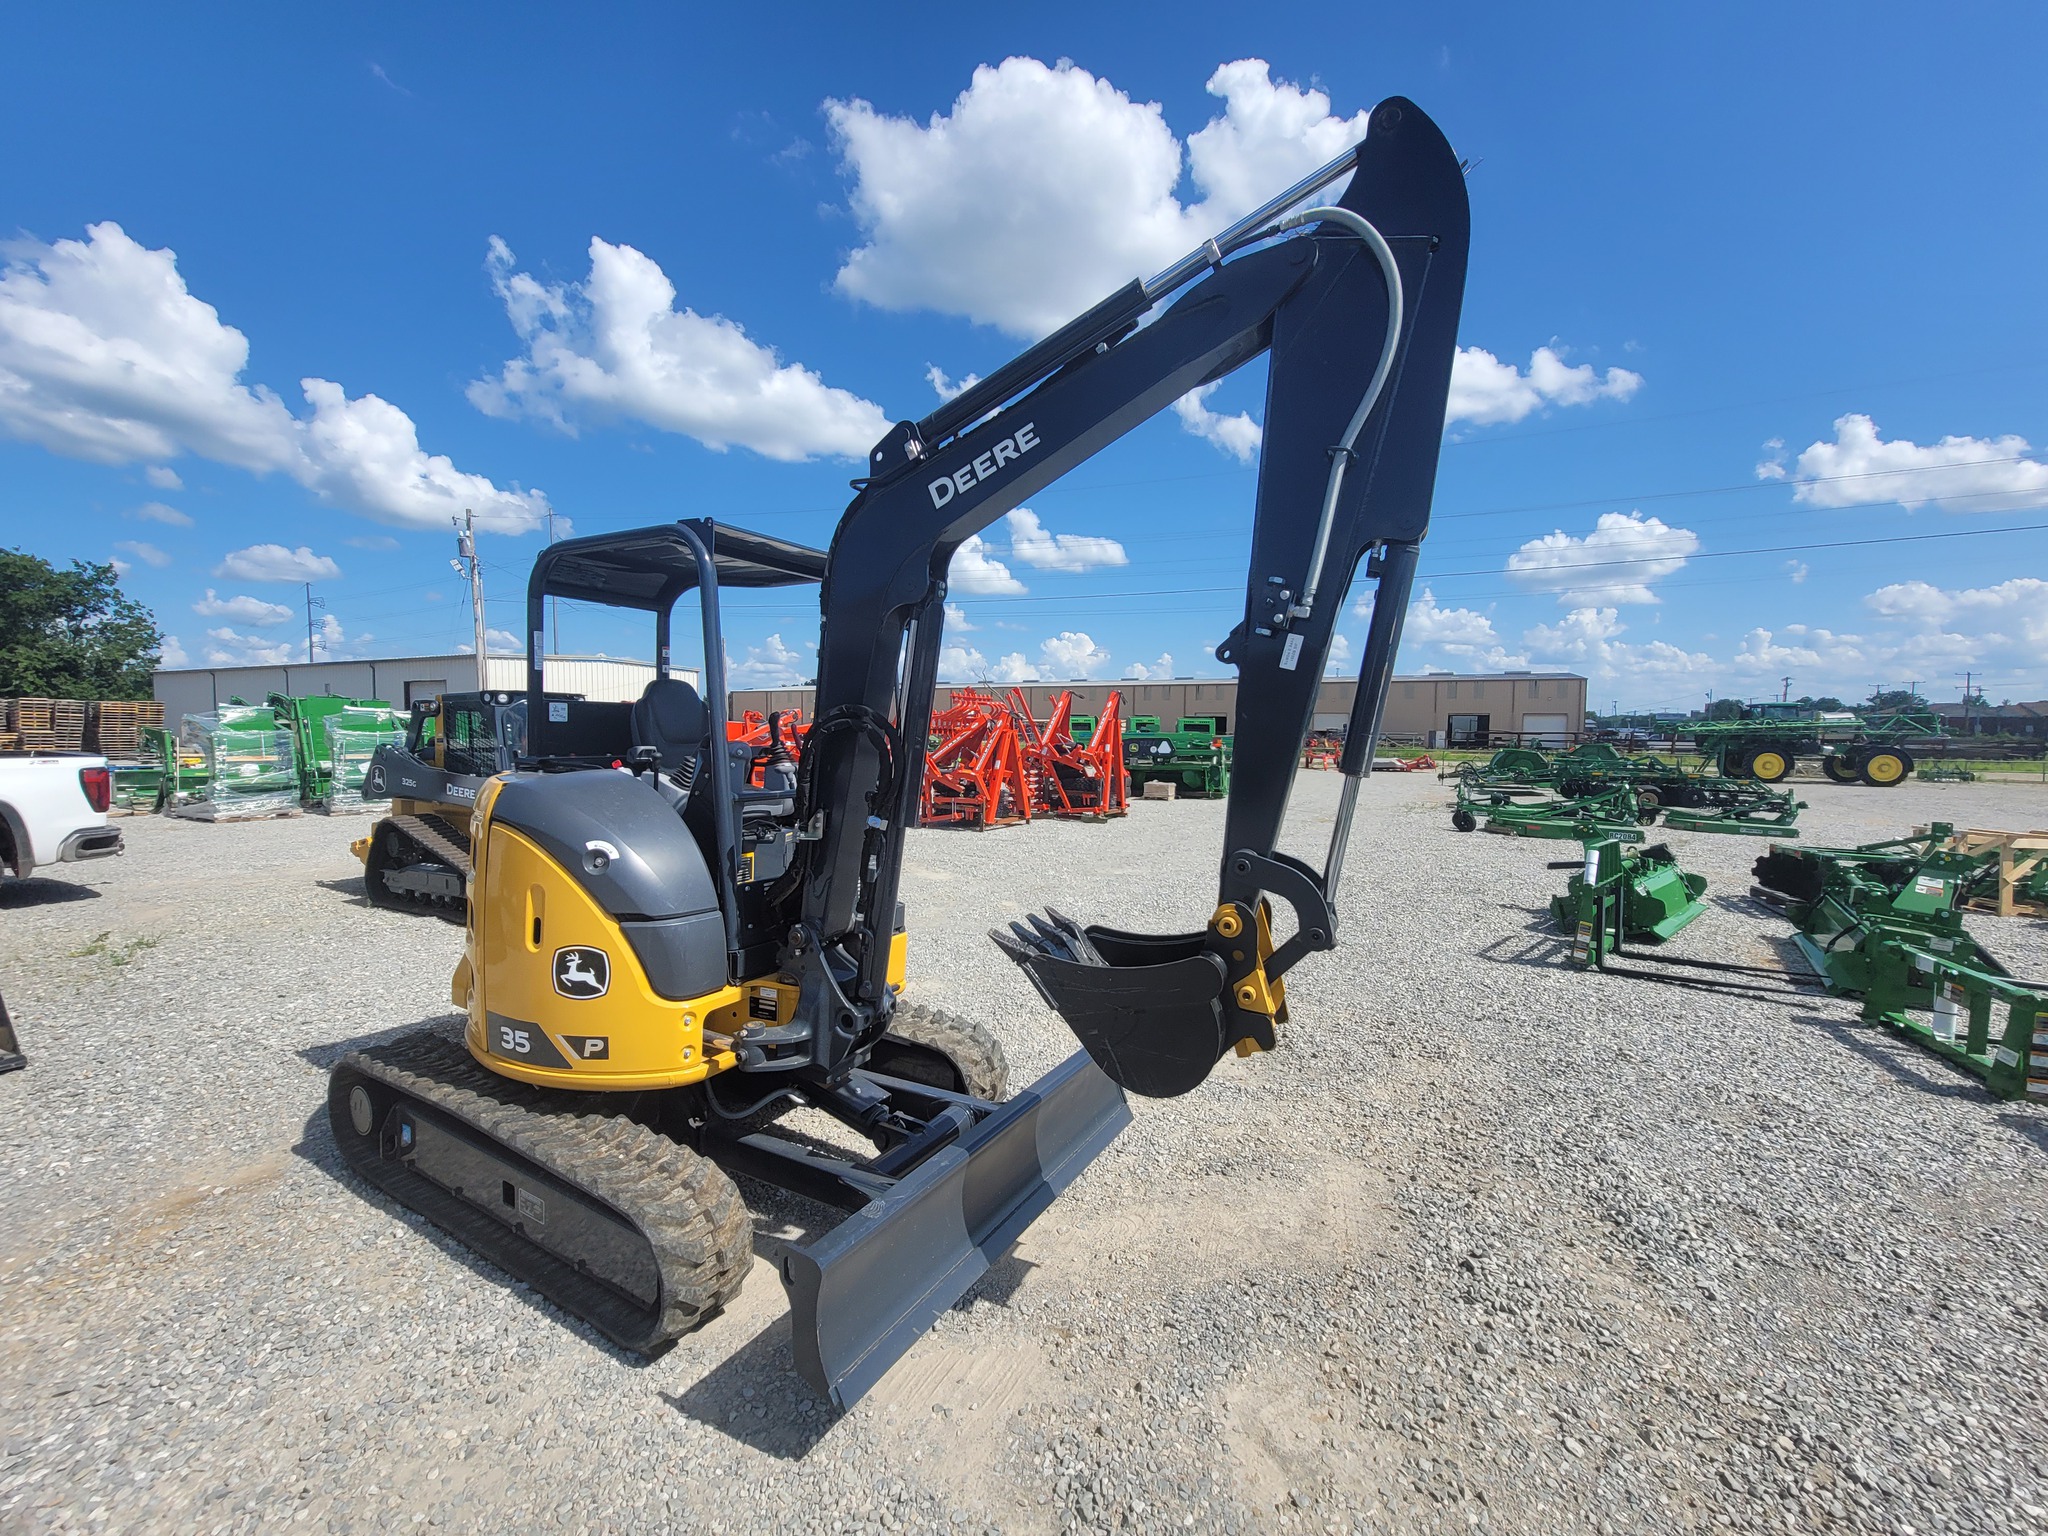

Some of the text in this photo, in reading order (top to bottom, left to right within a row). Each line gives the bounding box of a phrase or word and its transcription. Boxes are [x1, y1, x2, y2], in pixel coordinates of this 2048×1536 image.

[927, 421, 1041, 510] DEERE
[401, 777, 417, 788] 325G
[446, 783, 476, 799] DEERE
[500, 1026, 605, 1057] 35 P
